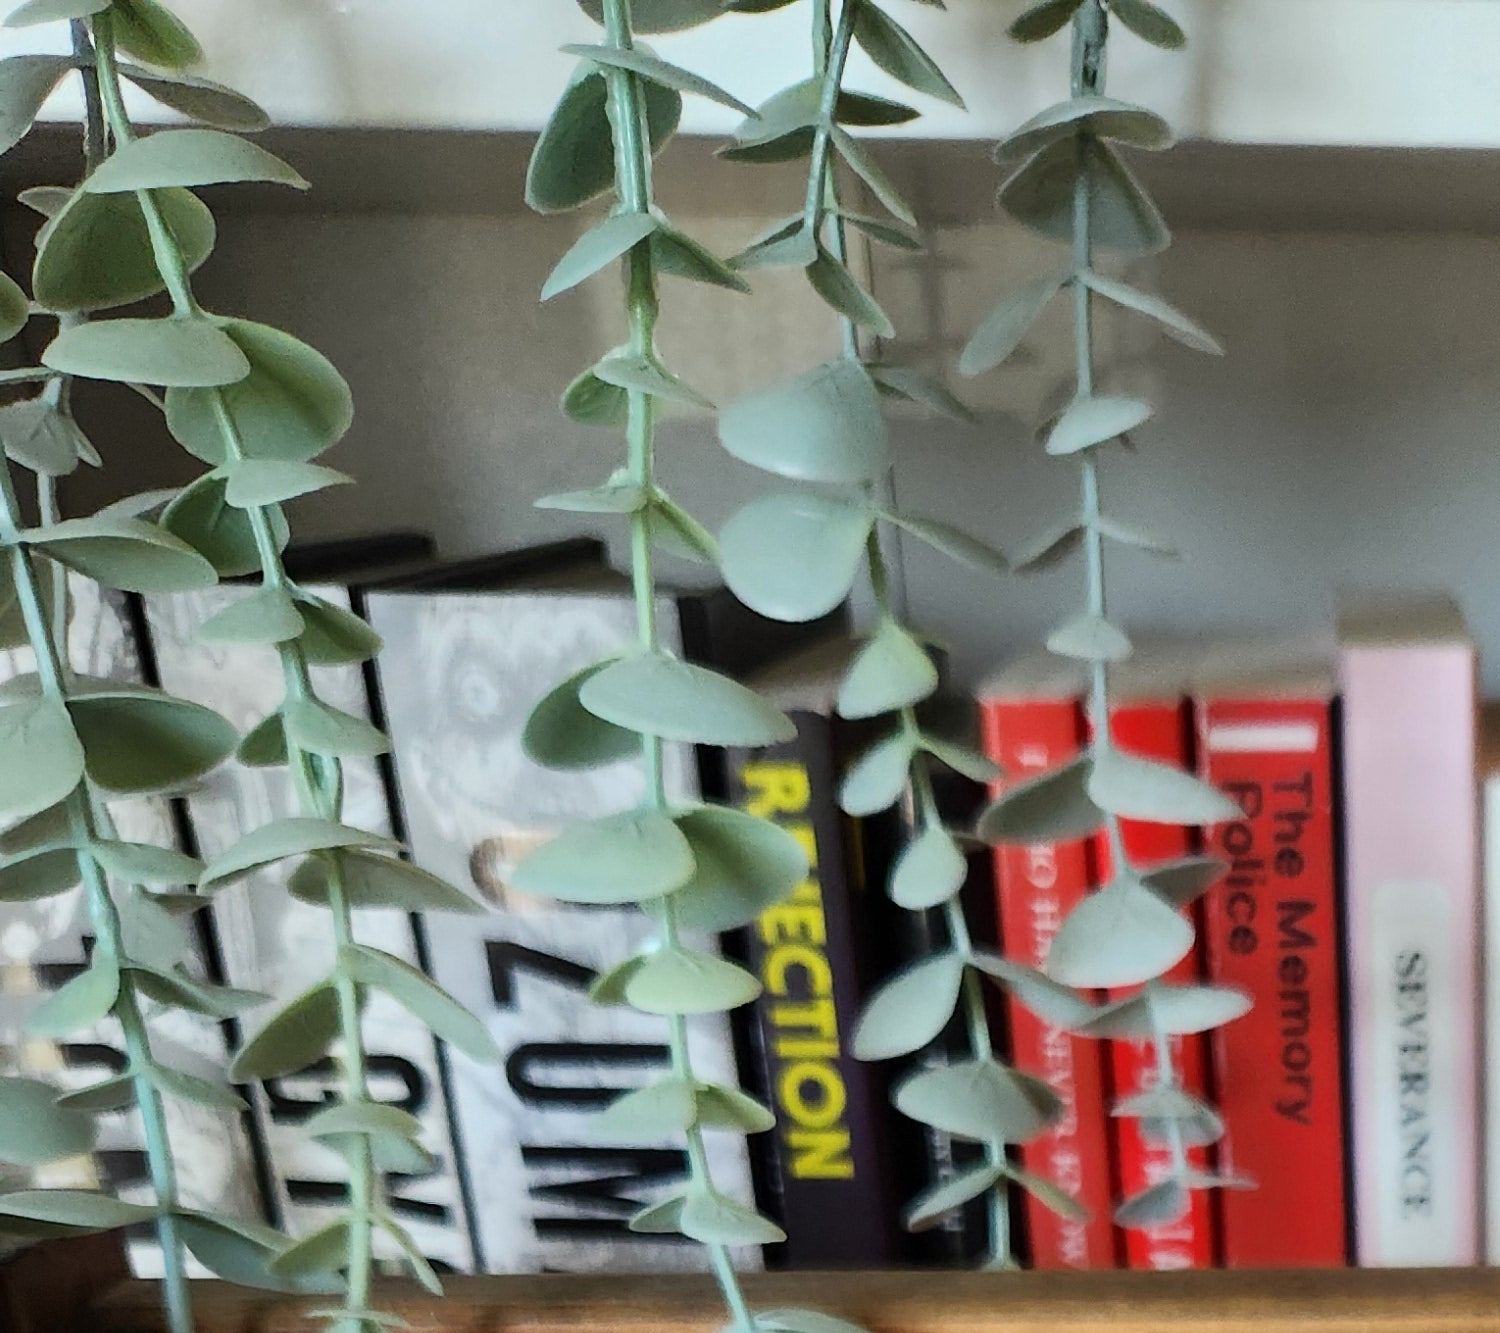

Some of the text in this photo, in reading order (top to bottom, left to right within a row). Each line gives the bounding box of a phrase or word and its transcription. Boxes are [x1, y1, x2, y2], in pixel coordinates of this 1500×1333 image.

[1221, 778, 1267, 958] Police
[1273, 770, 1319, 1128] The Memory
[1395, 947, 1433, 1219] SEVERANCE
